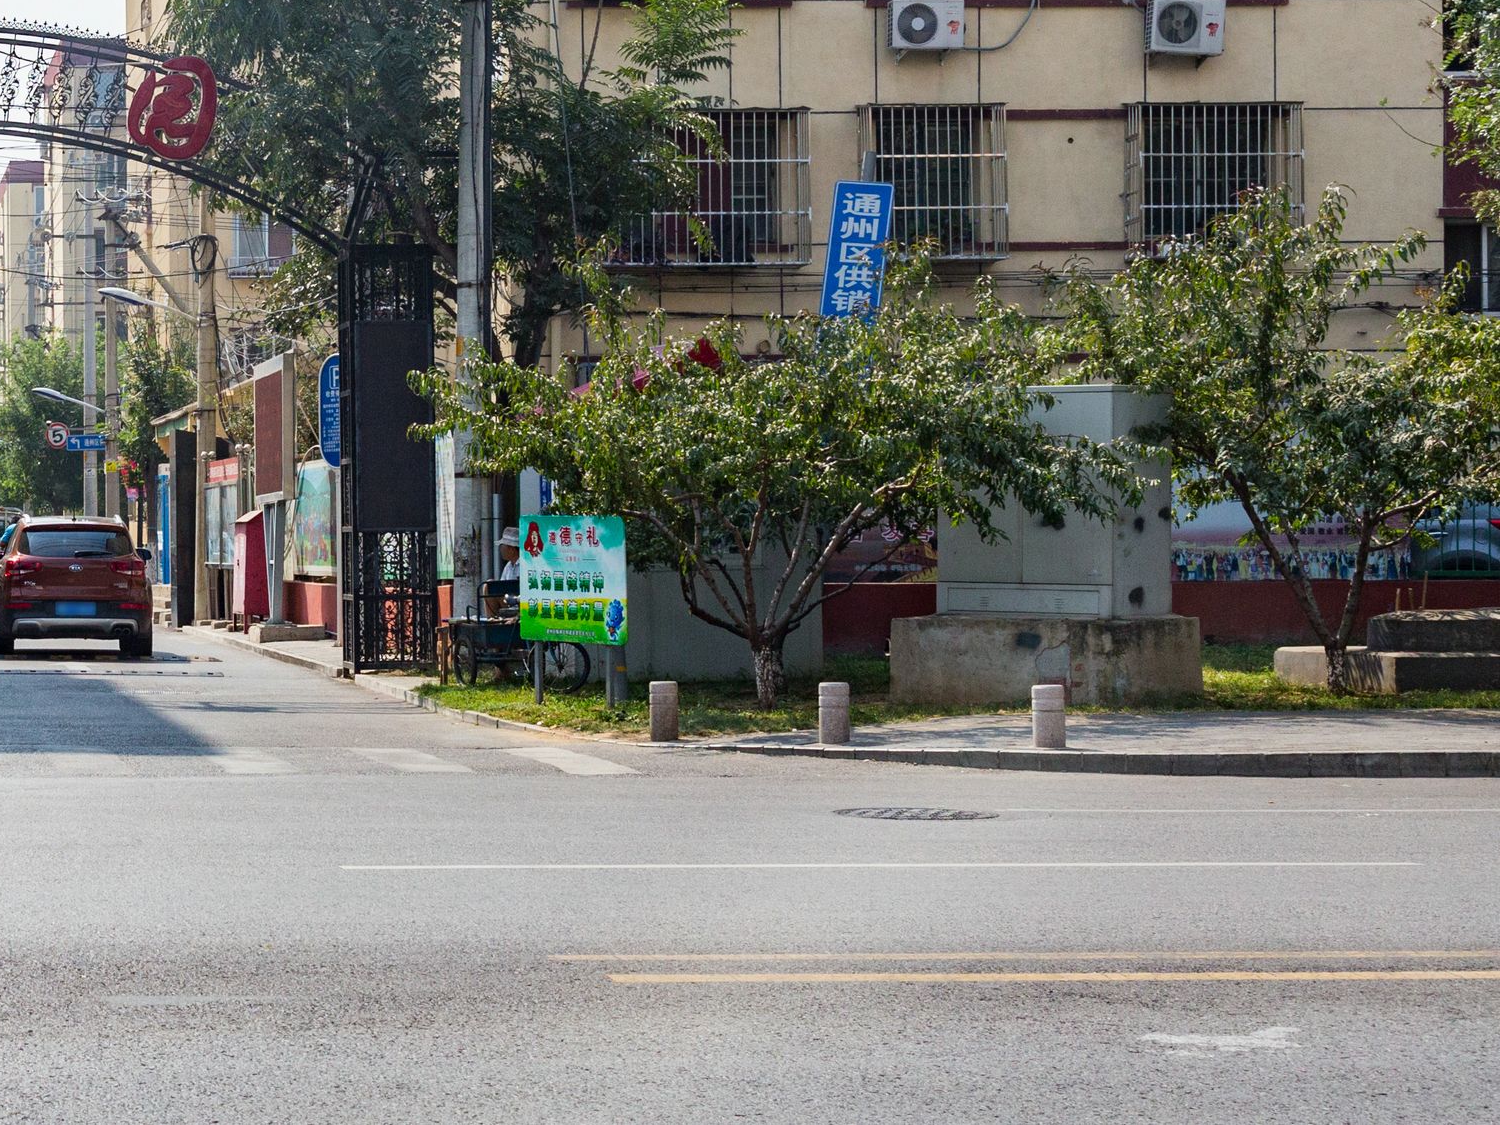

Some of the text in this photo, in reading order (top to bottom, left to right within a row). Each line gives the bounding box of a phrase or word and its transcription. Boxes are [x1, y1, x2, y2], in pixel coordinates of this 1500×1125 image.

[51, 429, 64, 444] 5
[527, 570, 604, 593] 弘扬雷锋精神
